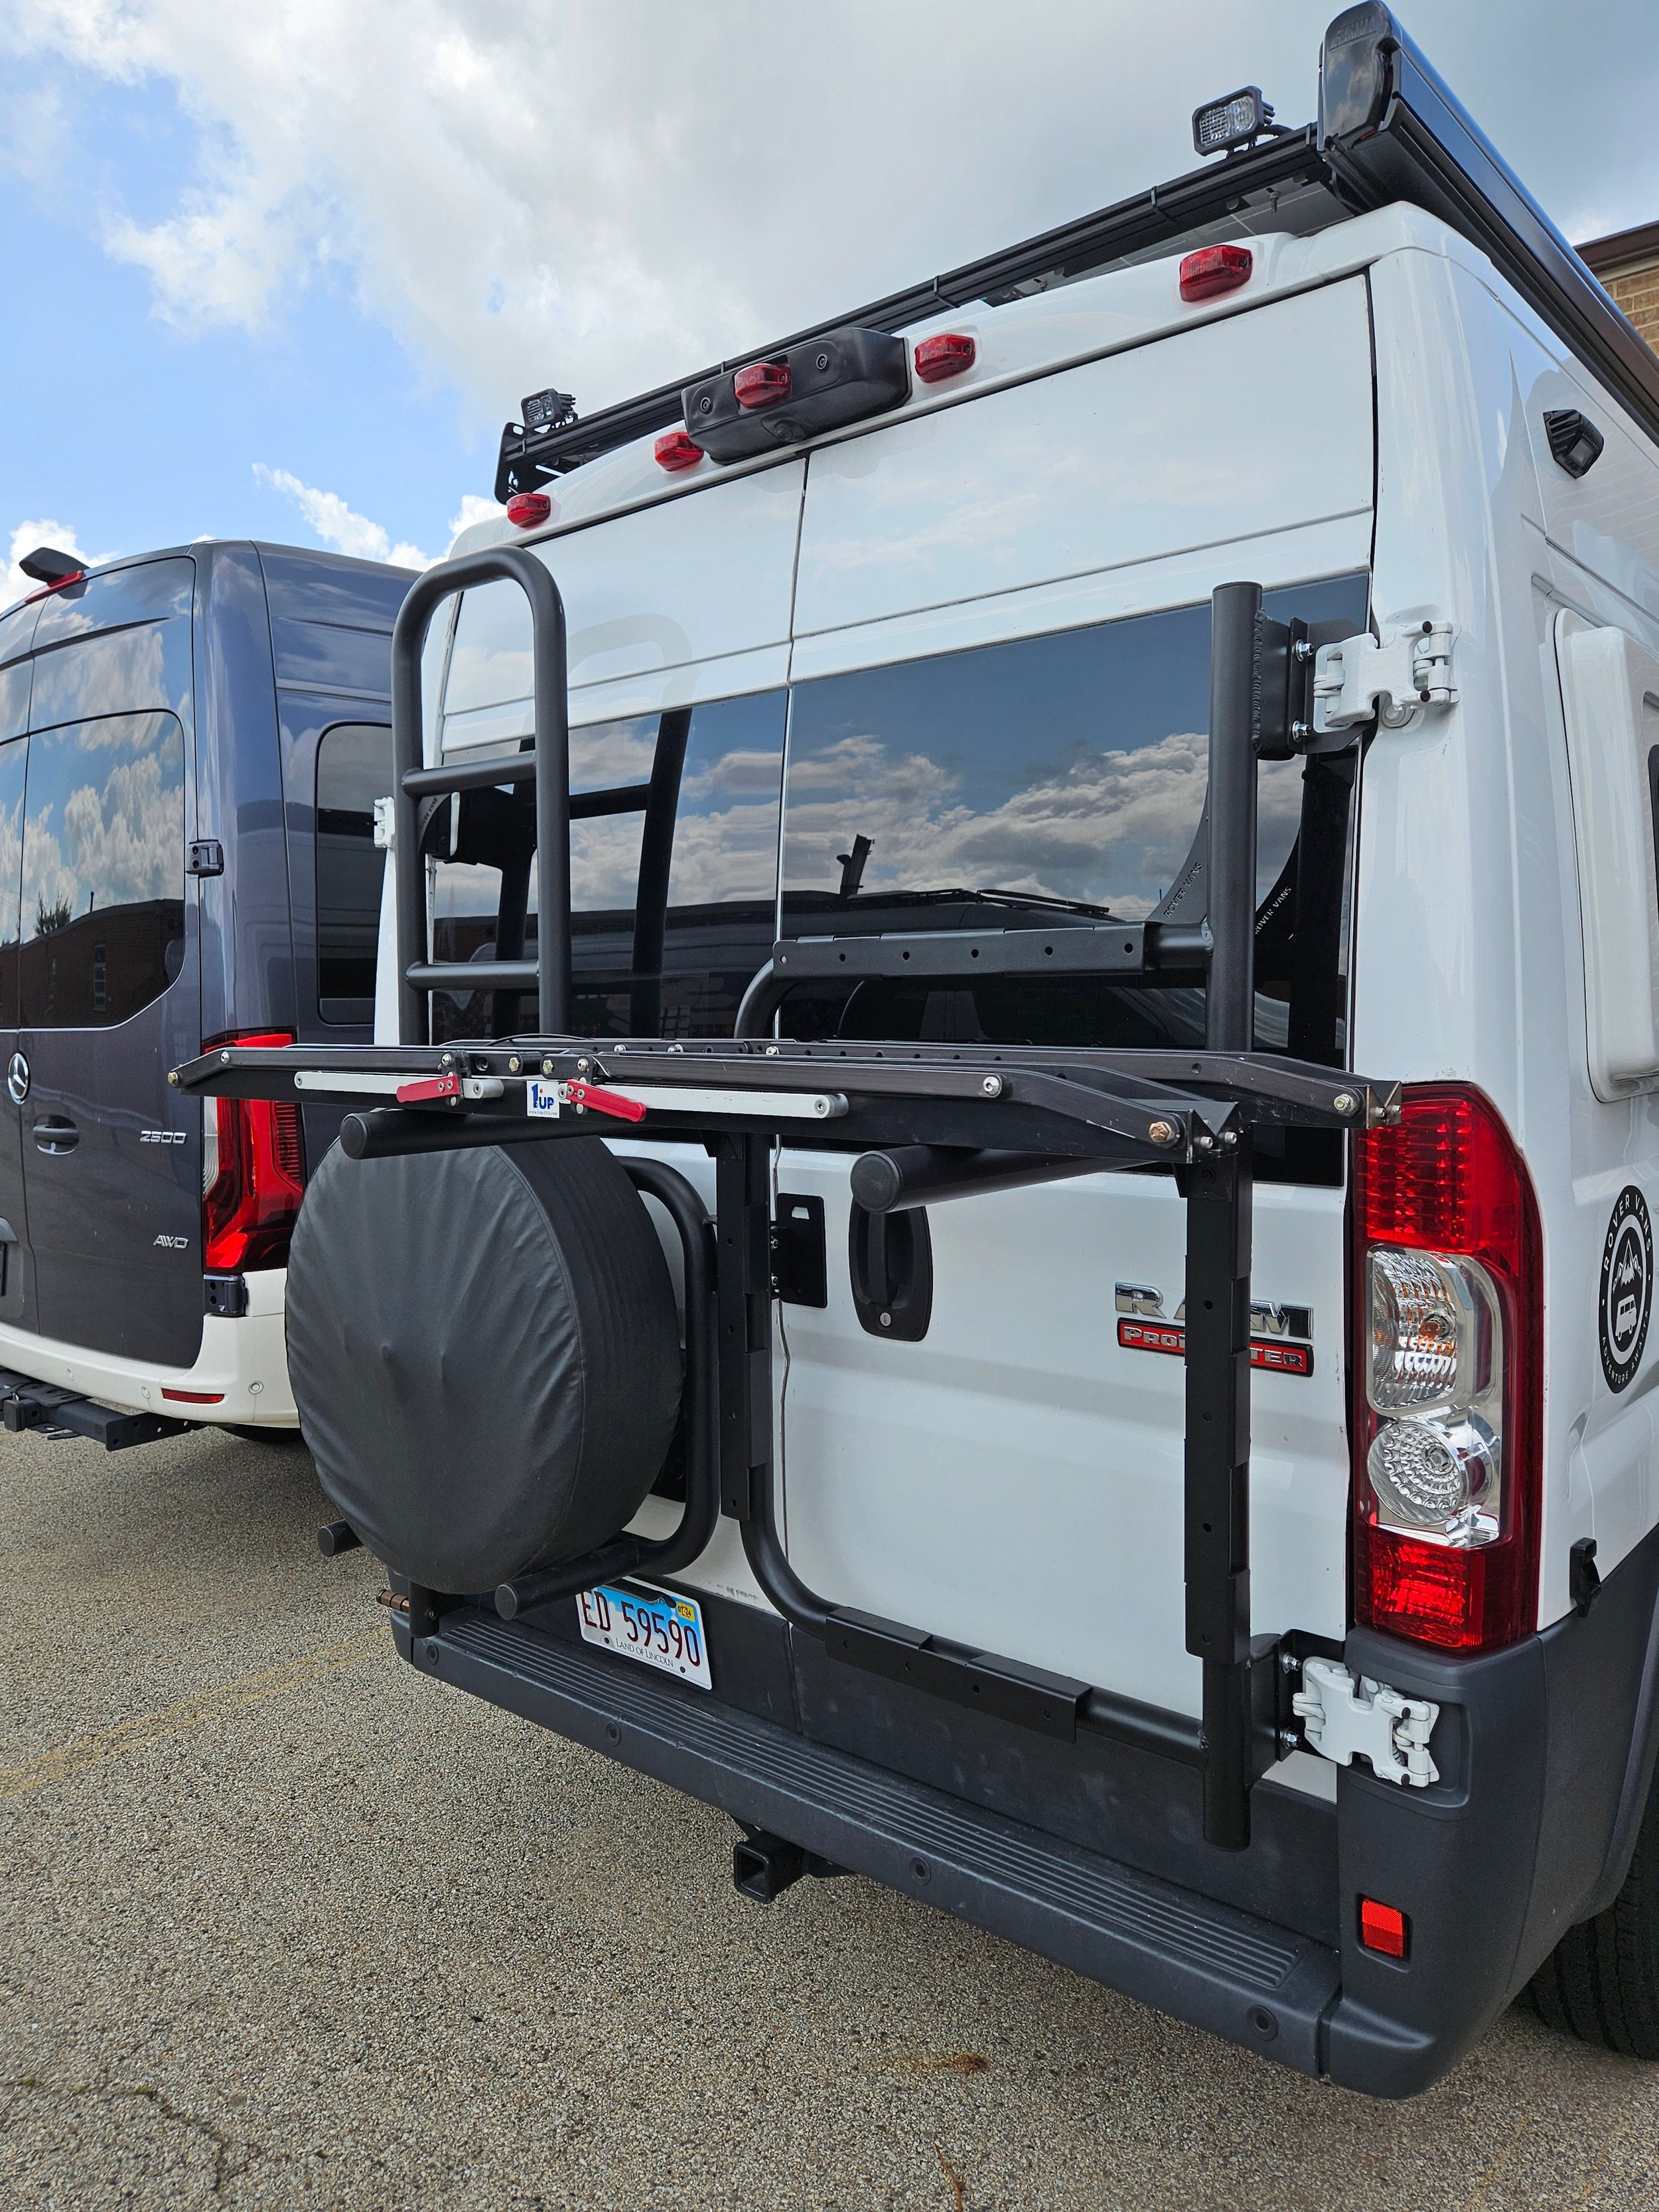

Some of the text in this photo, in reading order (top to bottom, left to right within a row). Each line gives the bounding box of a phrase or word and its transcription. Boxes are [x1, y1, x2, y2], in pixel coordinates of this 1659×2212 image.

[1163, 861, 1203, 918] ROVER VANS
[1272, 886, 1291, 908] VANS
[139, 1130, 188, 1145] 2500
[152, 1234, 189, 1250] AWD
[1603, 1194, 1651, 1272] ROVER VANS
[1115, 1282, 1314, 1340] RM
[1123, 1326, 1303, 1368] PROTER
[580, 1591, 701, 1668] ED 59590
[615, 1637, 674, 1668] LAND OF LINCOLN
